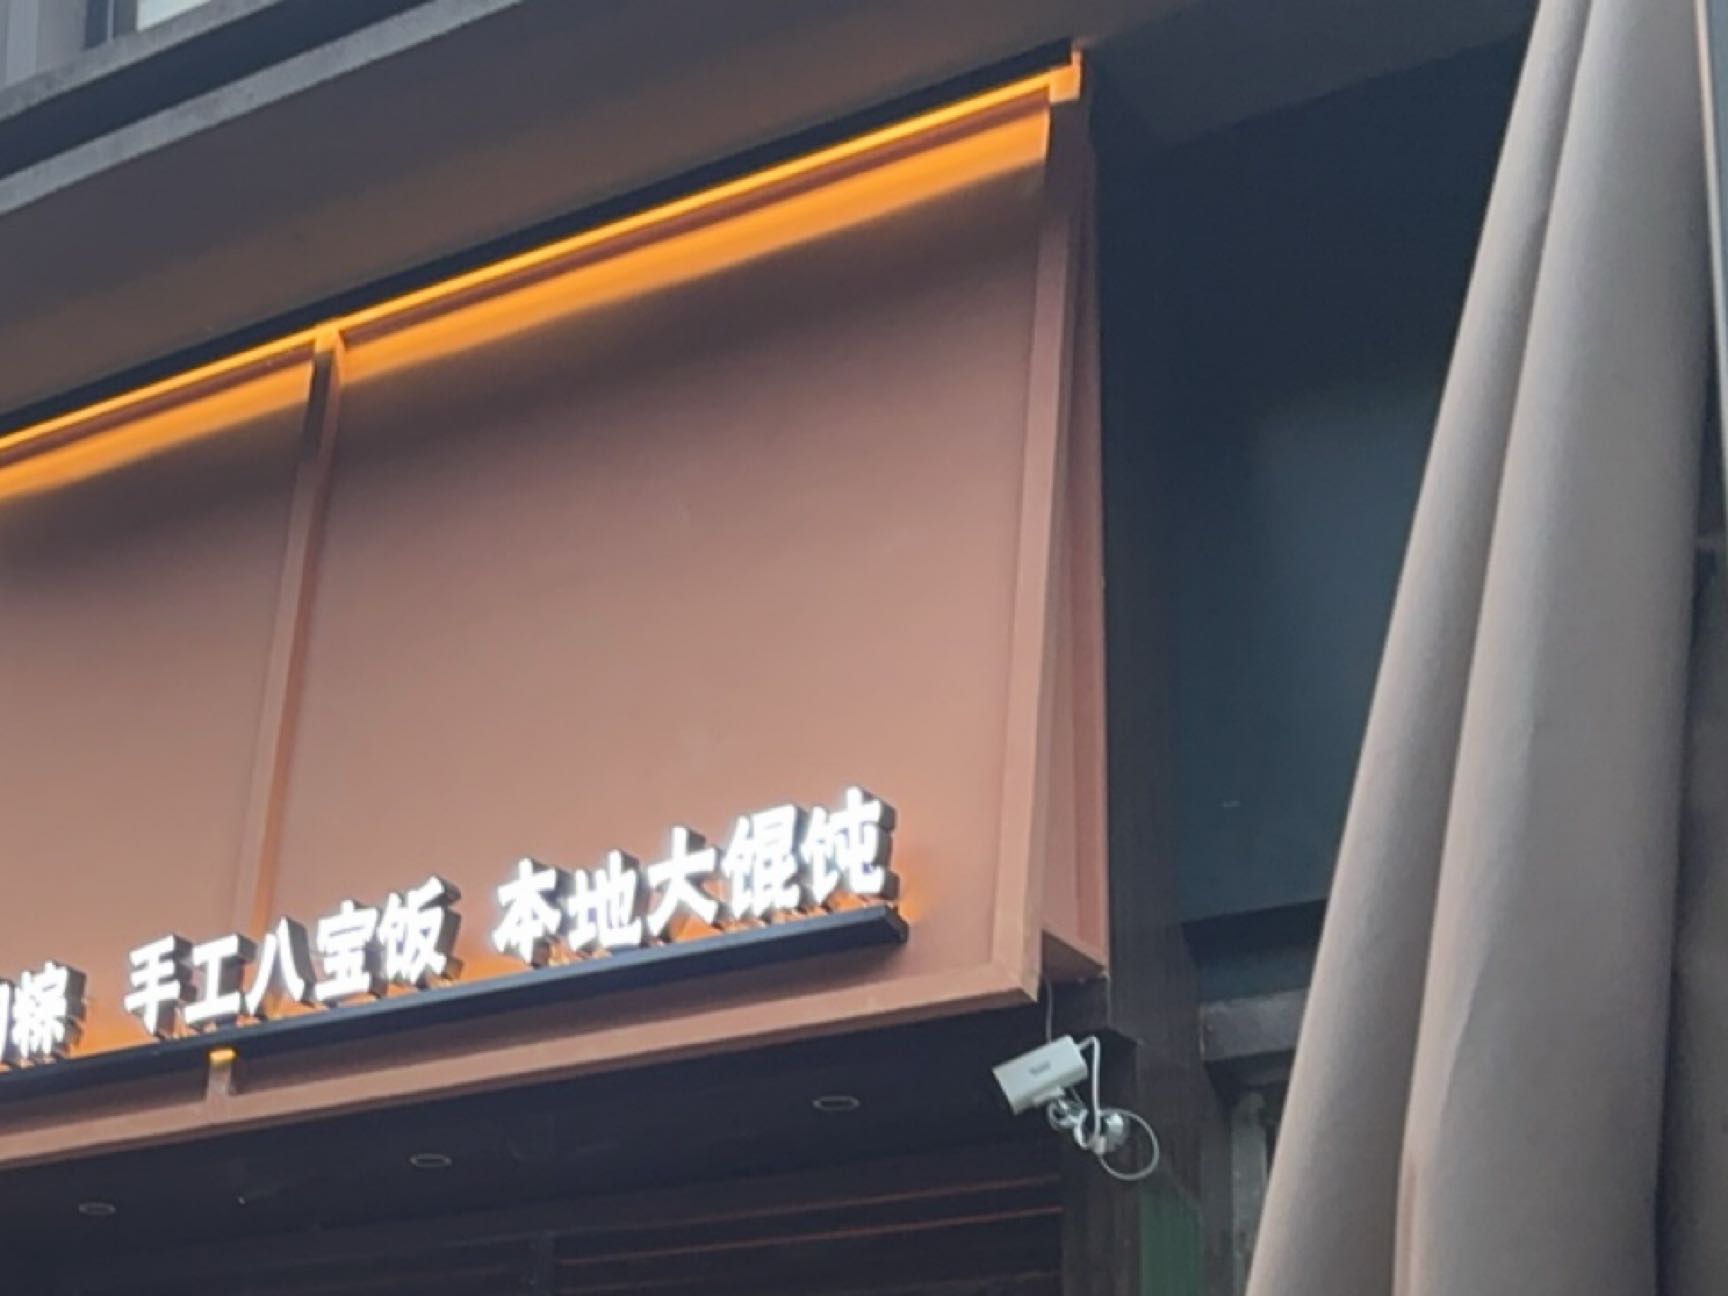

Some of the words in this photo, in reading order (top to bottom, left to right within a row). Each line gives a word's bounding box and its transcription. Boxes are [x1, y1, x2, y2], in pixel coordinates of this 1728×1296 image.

[123, 876, 447, 1036] 手工八宝饭
[491, 786, 886, 967] 本地大馄饨
